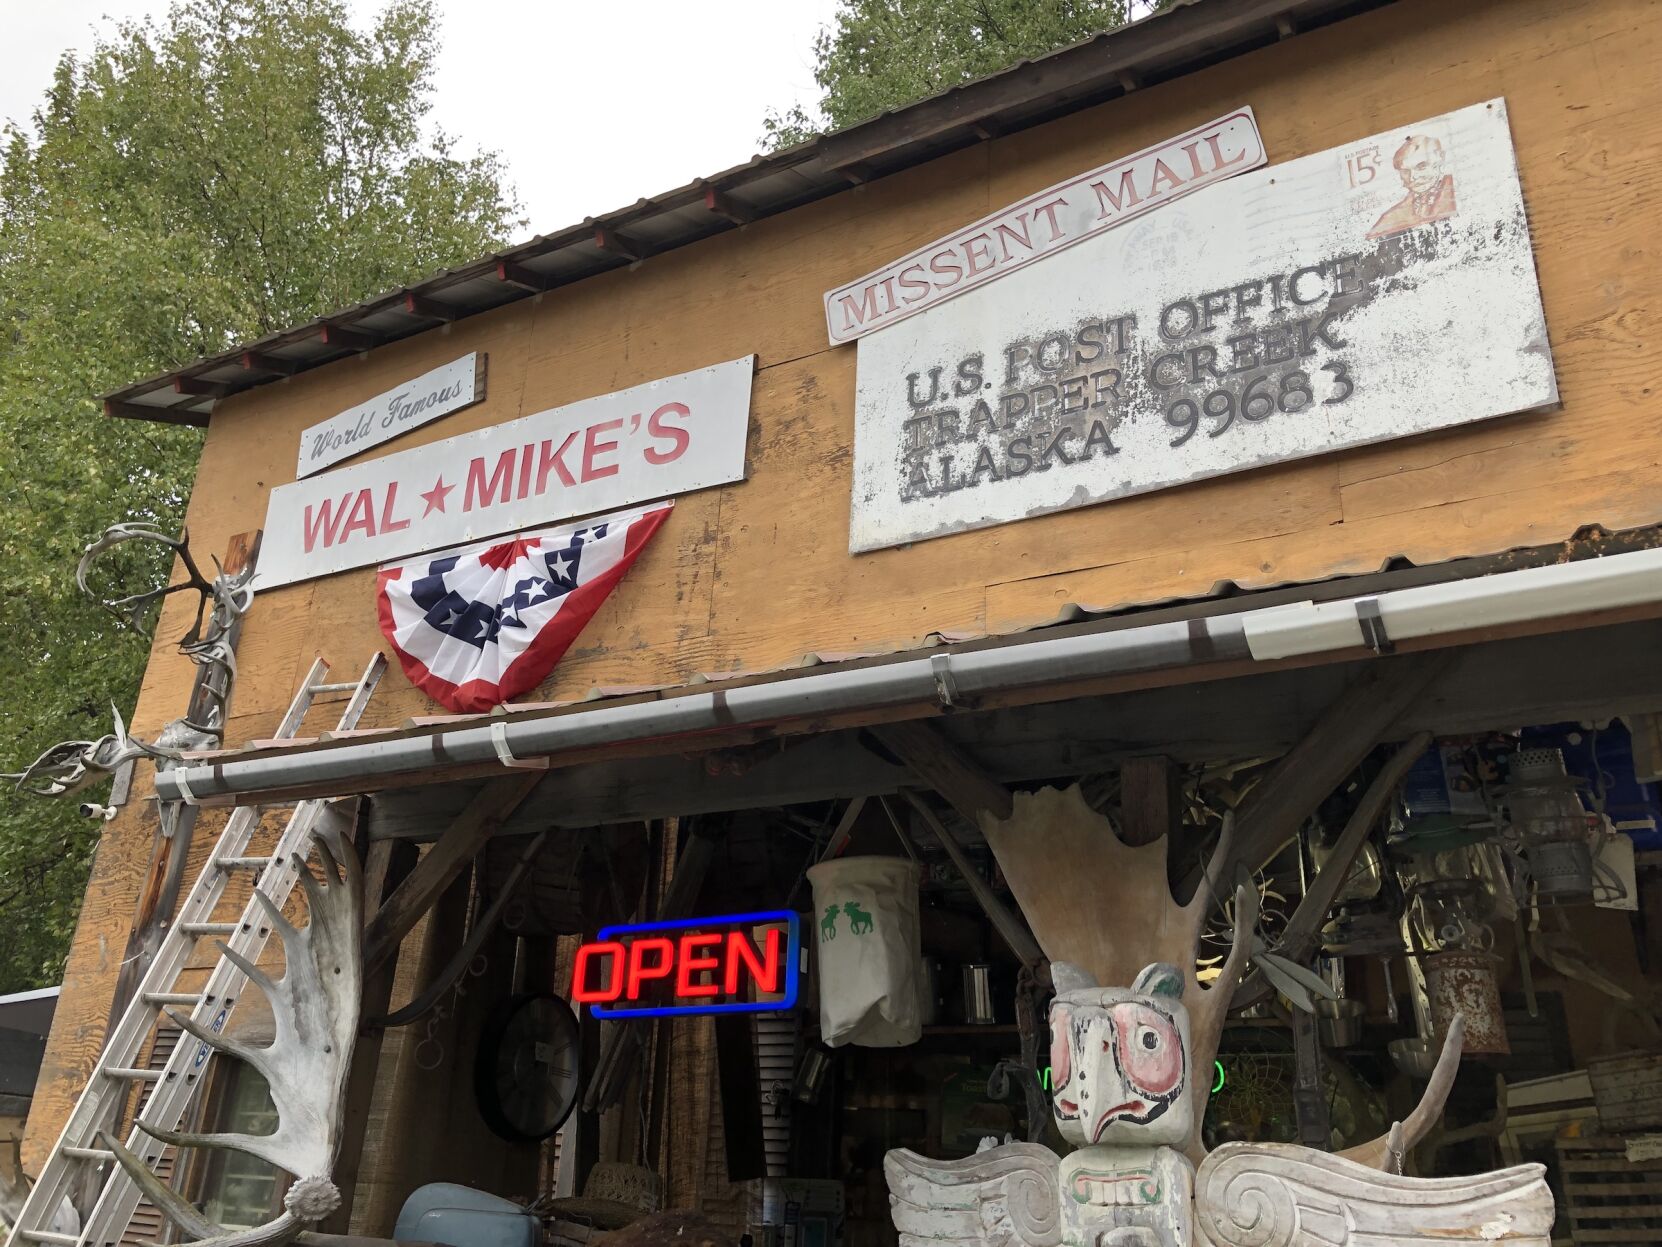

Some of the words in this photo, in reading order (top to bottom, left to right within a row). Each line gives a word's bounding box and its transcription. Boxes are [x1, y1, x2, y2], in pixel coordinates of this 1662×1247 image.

[841, 198, 1070, 331] MISSENT
[1090, 132, 1247, 221] MAIL
[903, 368, 1126, 450] TRAPPER
[1150, 312, 1348, 391] CREEK
[905, 352, 993, 408] U.S.
[1003, 313, 1138, 384] POST
[1160, 253, 1364, 341] OFFICE
[302, 480, 412, 554] WAL
[462, 401, 692, 513] MIKE'S
[311, 411, 377, 461] World
[381, 380, 463, 429] Famous
[900, 419, 1121, 502] ALASKA
[1166, 359, 1355, 448] 99683
[572, 928, 780, 1002] OPEN
